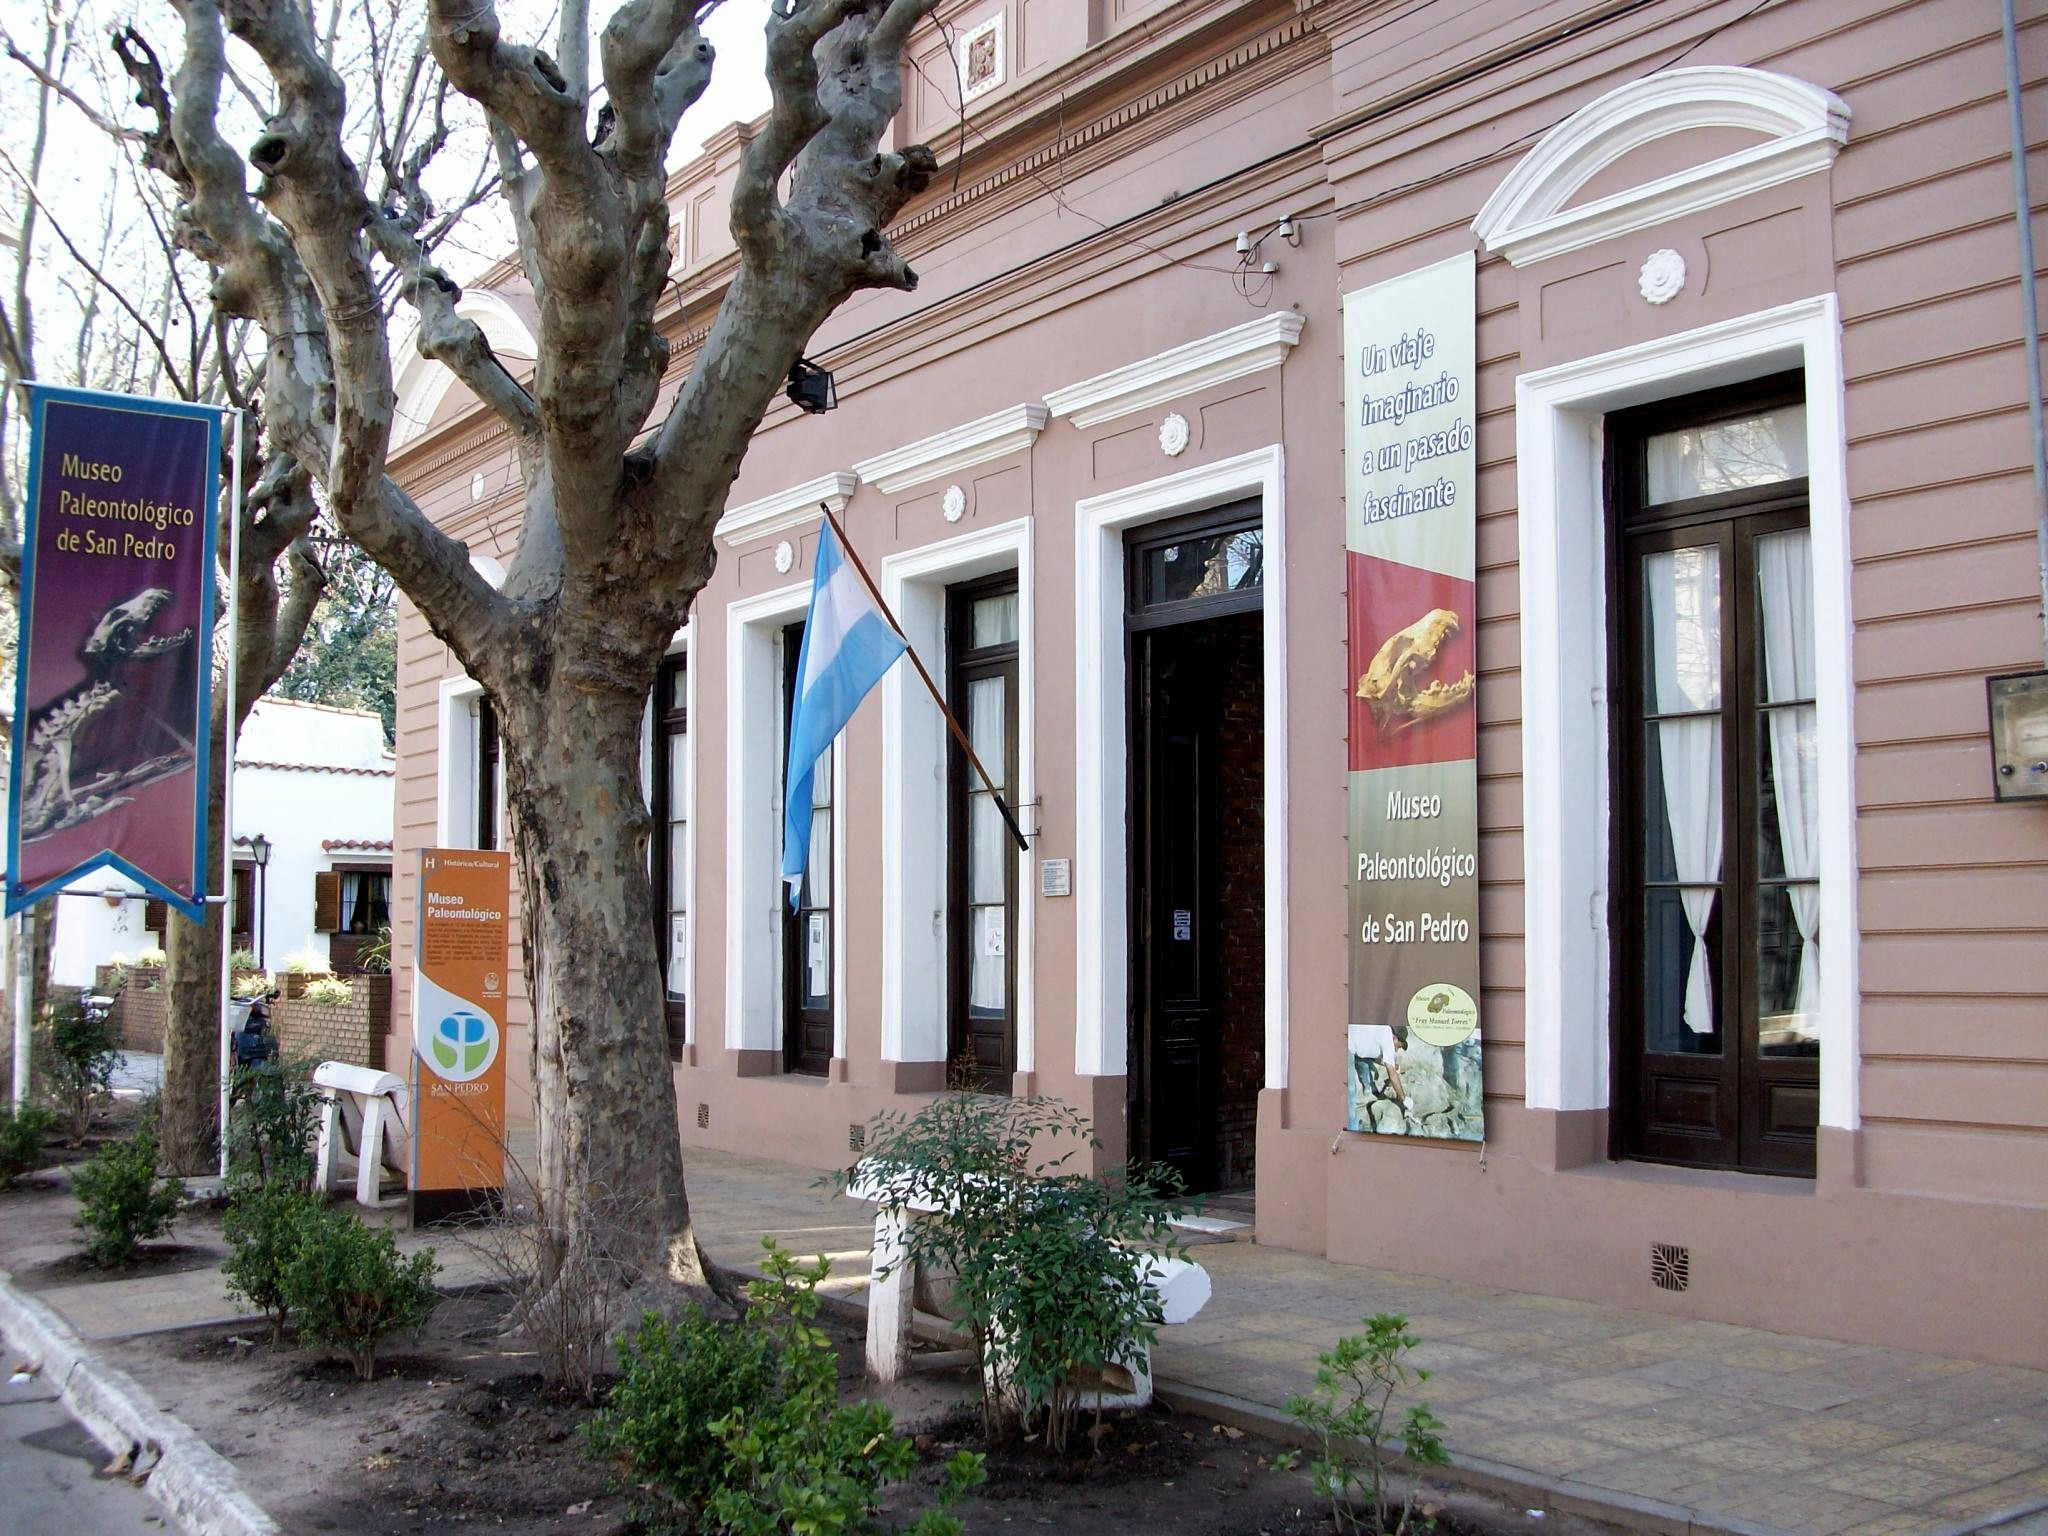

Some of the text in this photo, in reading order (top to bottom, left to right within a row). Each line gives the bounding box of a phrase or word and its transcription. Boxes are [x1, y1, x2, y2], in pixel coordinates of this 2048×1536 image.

[1361, 327, 1435, 377] Un viaje
[1361, 370, 1460, 426] imaginario
[1362, 417, 1473, 475] a un pasado
[61, 453, 122, 483] Museo
[60, 490, 194, 531] Paleontológico
[1363, 477, 1456, 525] fascinante
[57, 527, 176, 560] de San Pedro
[1386, 790, 1441, 820] Museo
[425, 857, 435, 869] H
[1357, 846, 1475, 887] Paleontológico
[428, 892, 464, 905] Museo
[428, 906, 502, 922] Paleontológico
[1361, 911, 1469, 943] de San Pedro
[431, 1082, 489, 1093] SAN PEDRO
